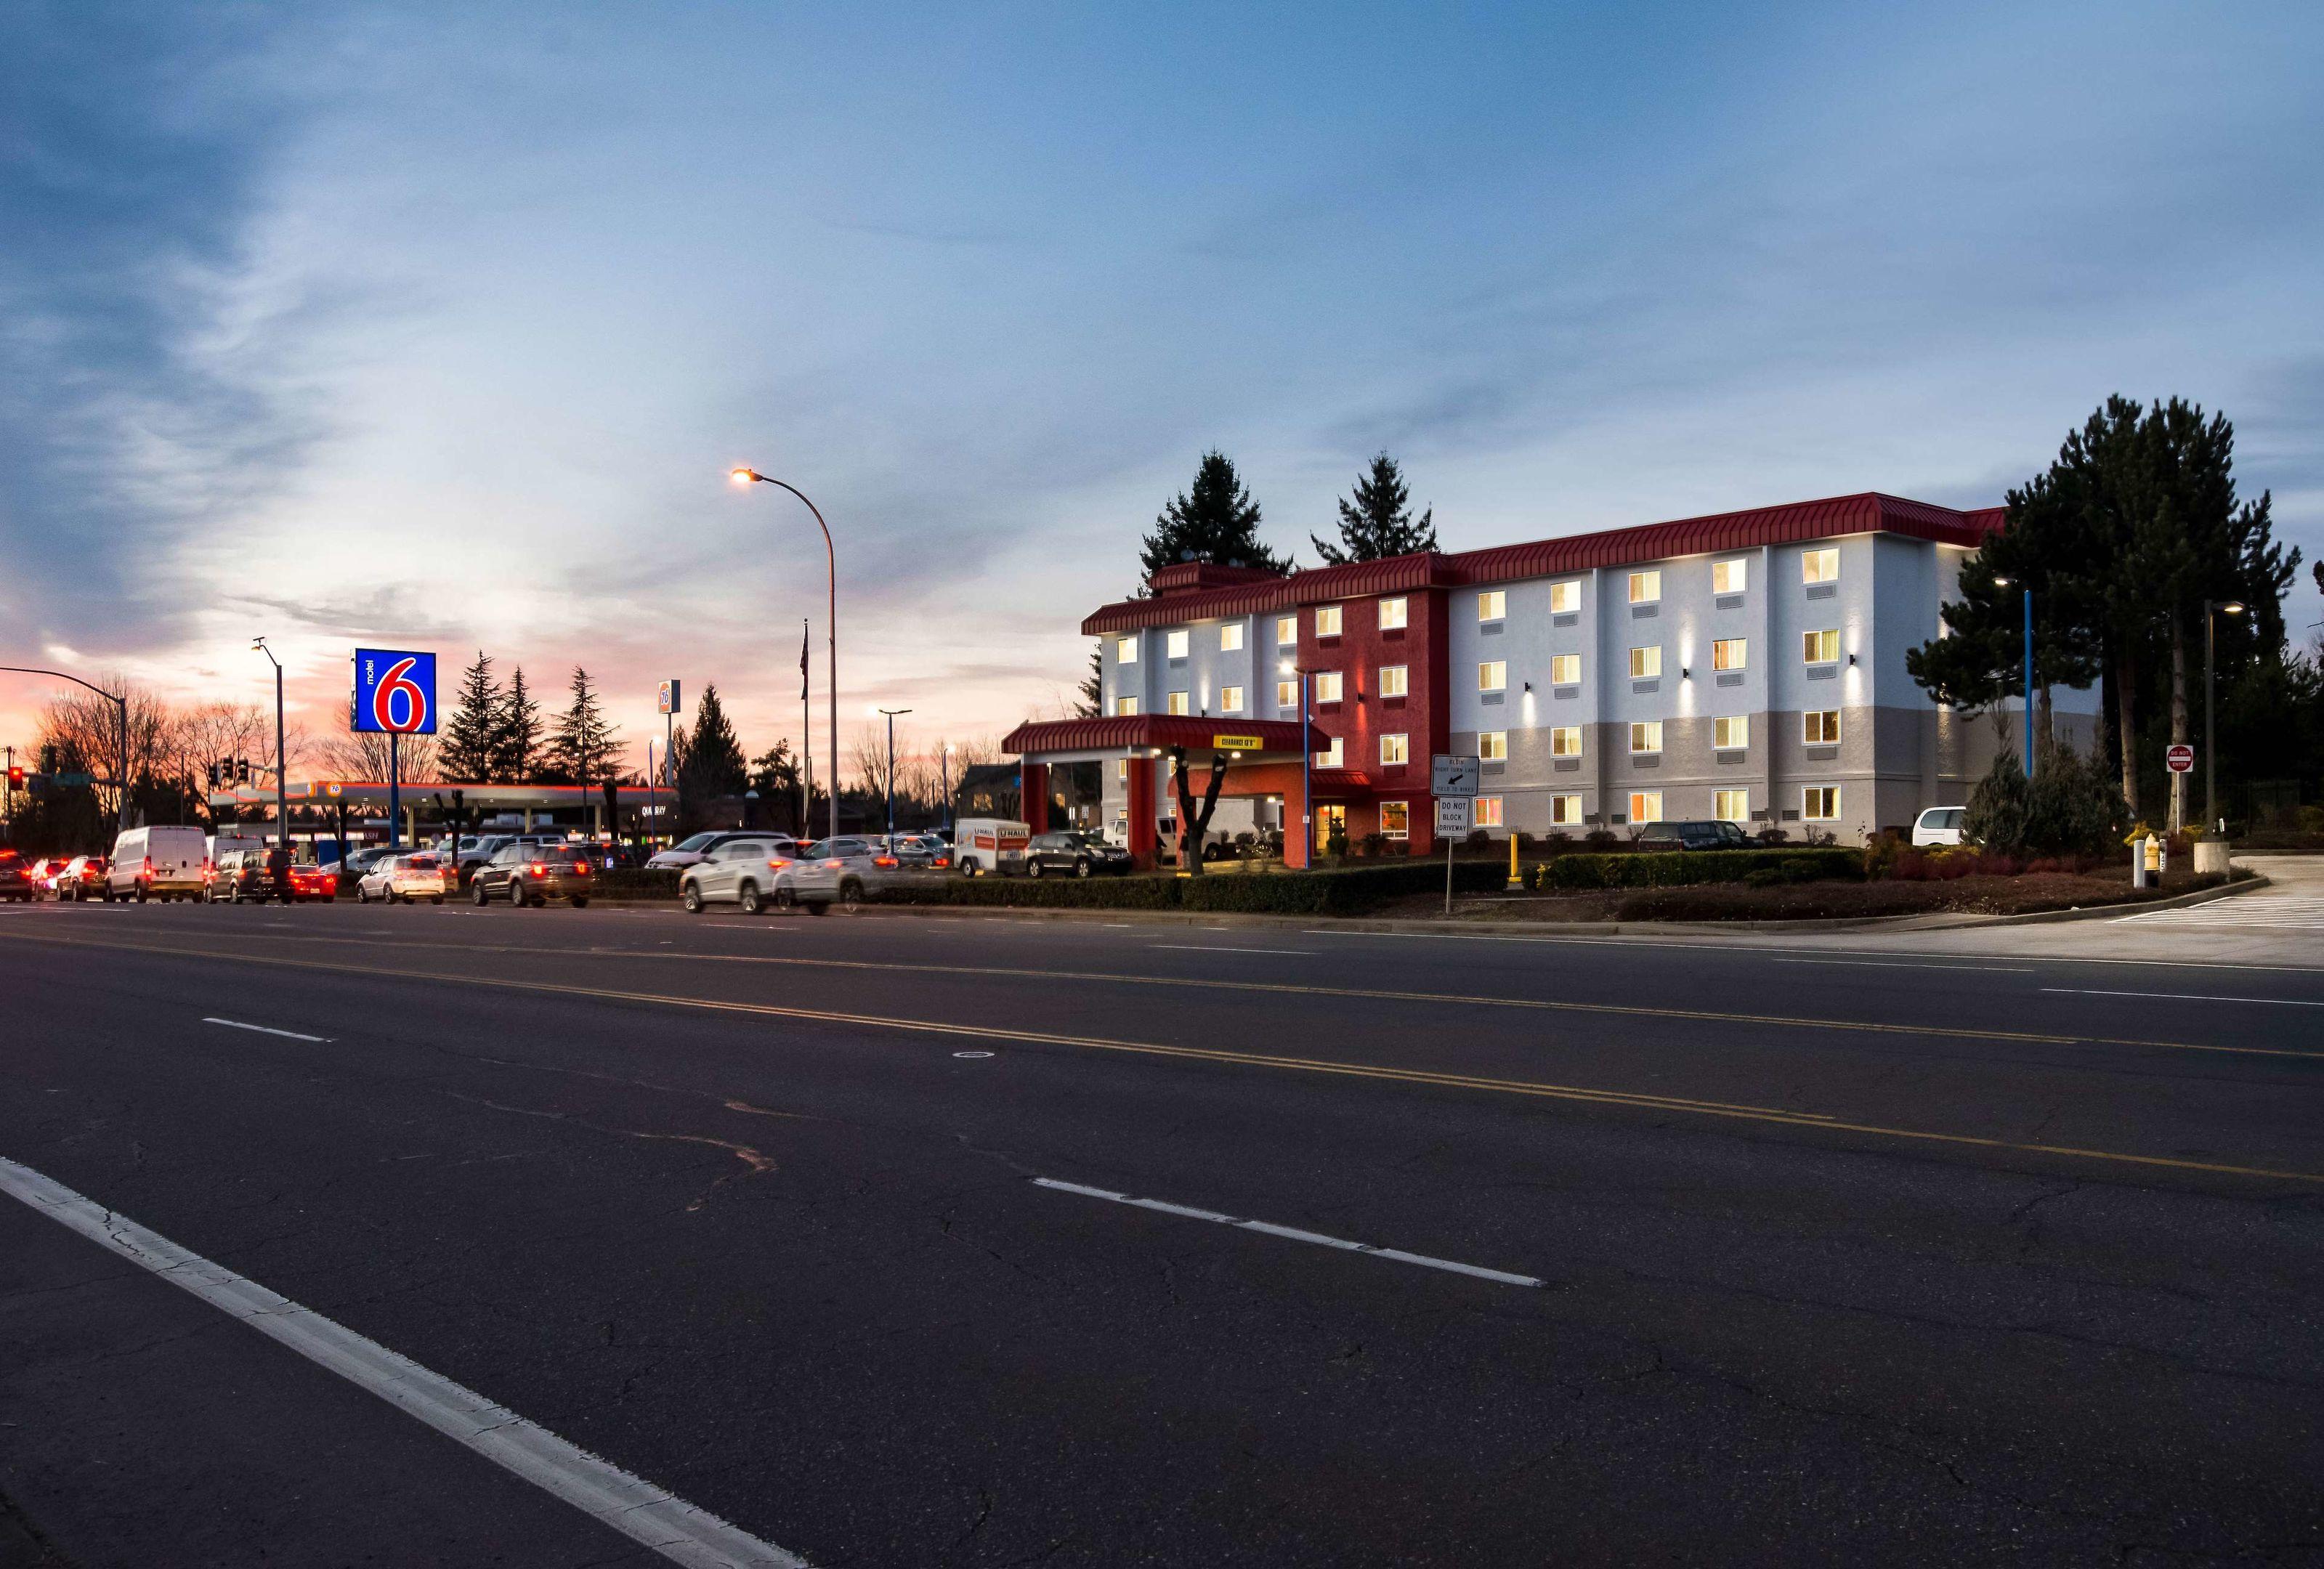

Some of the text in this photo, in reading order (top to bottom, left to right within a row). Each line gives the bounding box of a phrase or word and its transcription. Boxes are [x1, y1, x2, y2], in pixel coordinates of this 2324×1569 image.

[365, 660, 374, 685] motel
[373, 657, 427, 731] 6
[661, 689, 669, 704] 76
